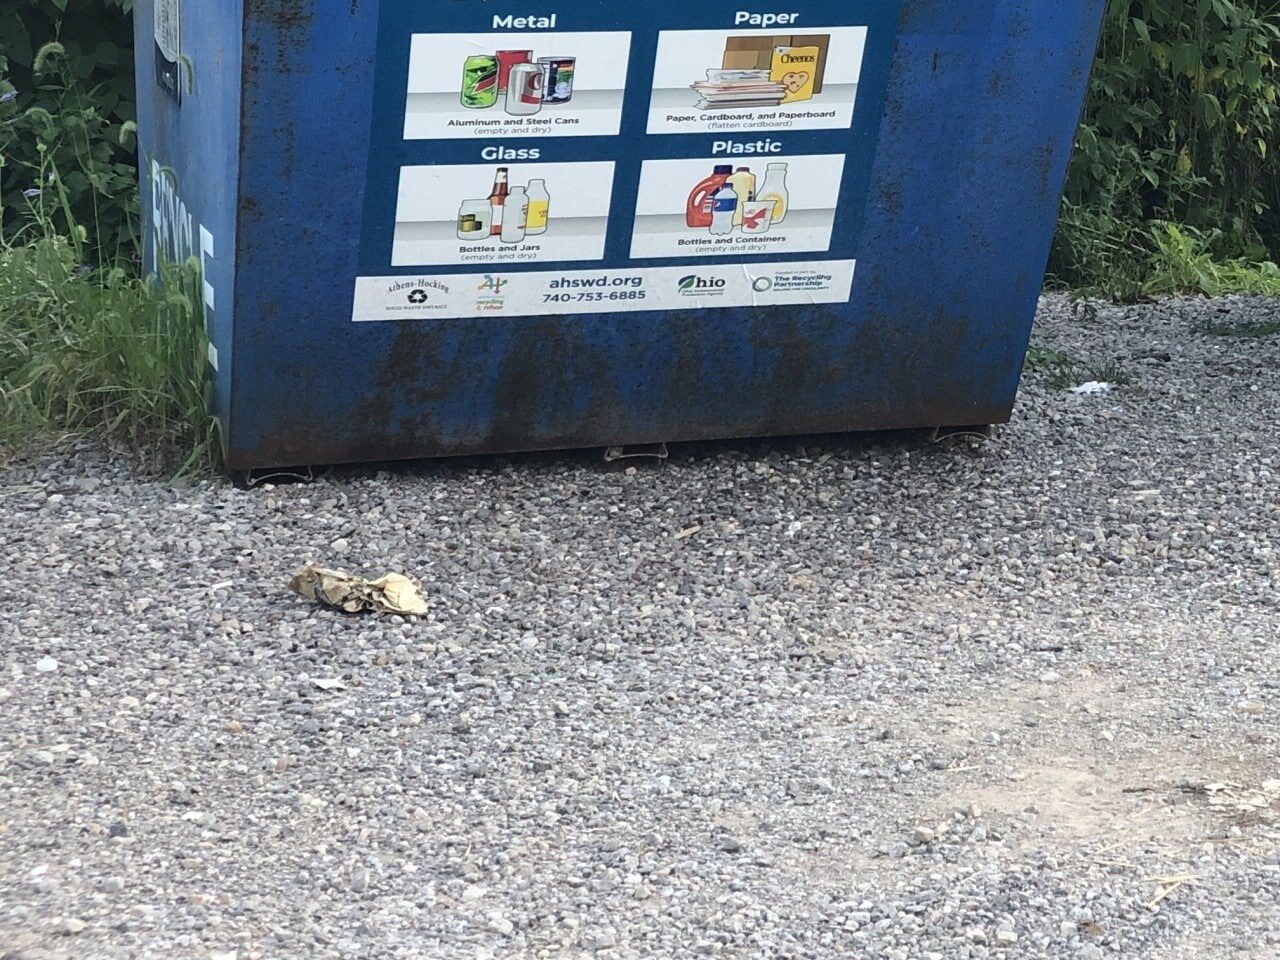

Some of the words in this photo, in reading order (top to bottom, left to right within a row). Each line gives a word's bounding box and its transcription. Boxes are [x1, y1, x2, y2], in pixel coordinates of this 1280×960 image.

[492, 13, 557, 29] Metal
[734, 11, 800, 28] Paper
[447, 118, 501, 127] Aluminum
[503, 118, 524, 126] and
[526, 117, 552, 125] Steel
[554, 117, 580, 125] Cans
[665, 114, 697, 123] Paper,
[699, 112, 756, 122] Cardboard,
[757, 111, 776, 120] and
[778, 110, 836, 120] Paperboard
[707, 120, 741, 130] (flatten
[743, 120, 793, 129] cardboard)
[473, 127, 508, 136] (empty
[510, 126, 530, 134] and
[531, 126, 552, 135] dry)
[711, 138, 783, 155] Plastic
[480, 145, 541, 161] Glass
[677, 238, 713, 246] Bottles
[714, 236, 733, 245] and
[735, 235, 787, 244] Containers
[459, 244, 496, 253] Bottles
[498, 244, 517, 252] and
[520, 243, 541, 252] Jars
[695, 245, 727, 254] (empty
[729, 244, 746, 252] and
[747, 243, 767, 252] dry)
[460, 253, 496, 262] (empty
[497, 252, 516, 260] and
[517, 252, 537, 261] dry)
[549, 275, 643, 289] ahswd.org
[773, 280, 823, 288] Partnership
[542, 290, 646, 304] 740-753-6885
